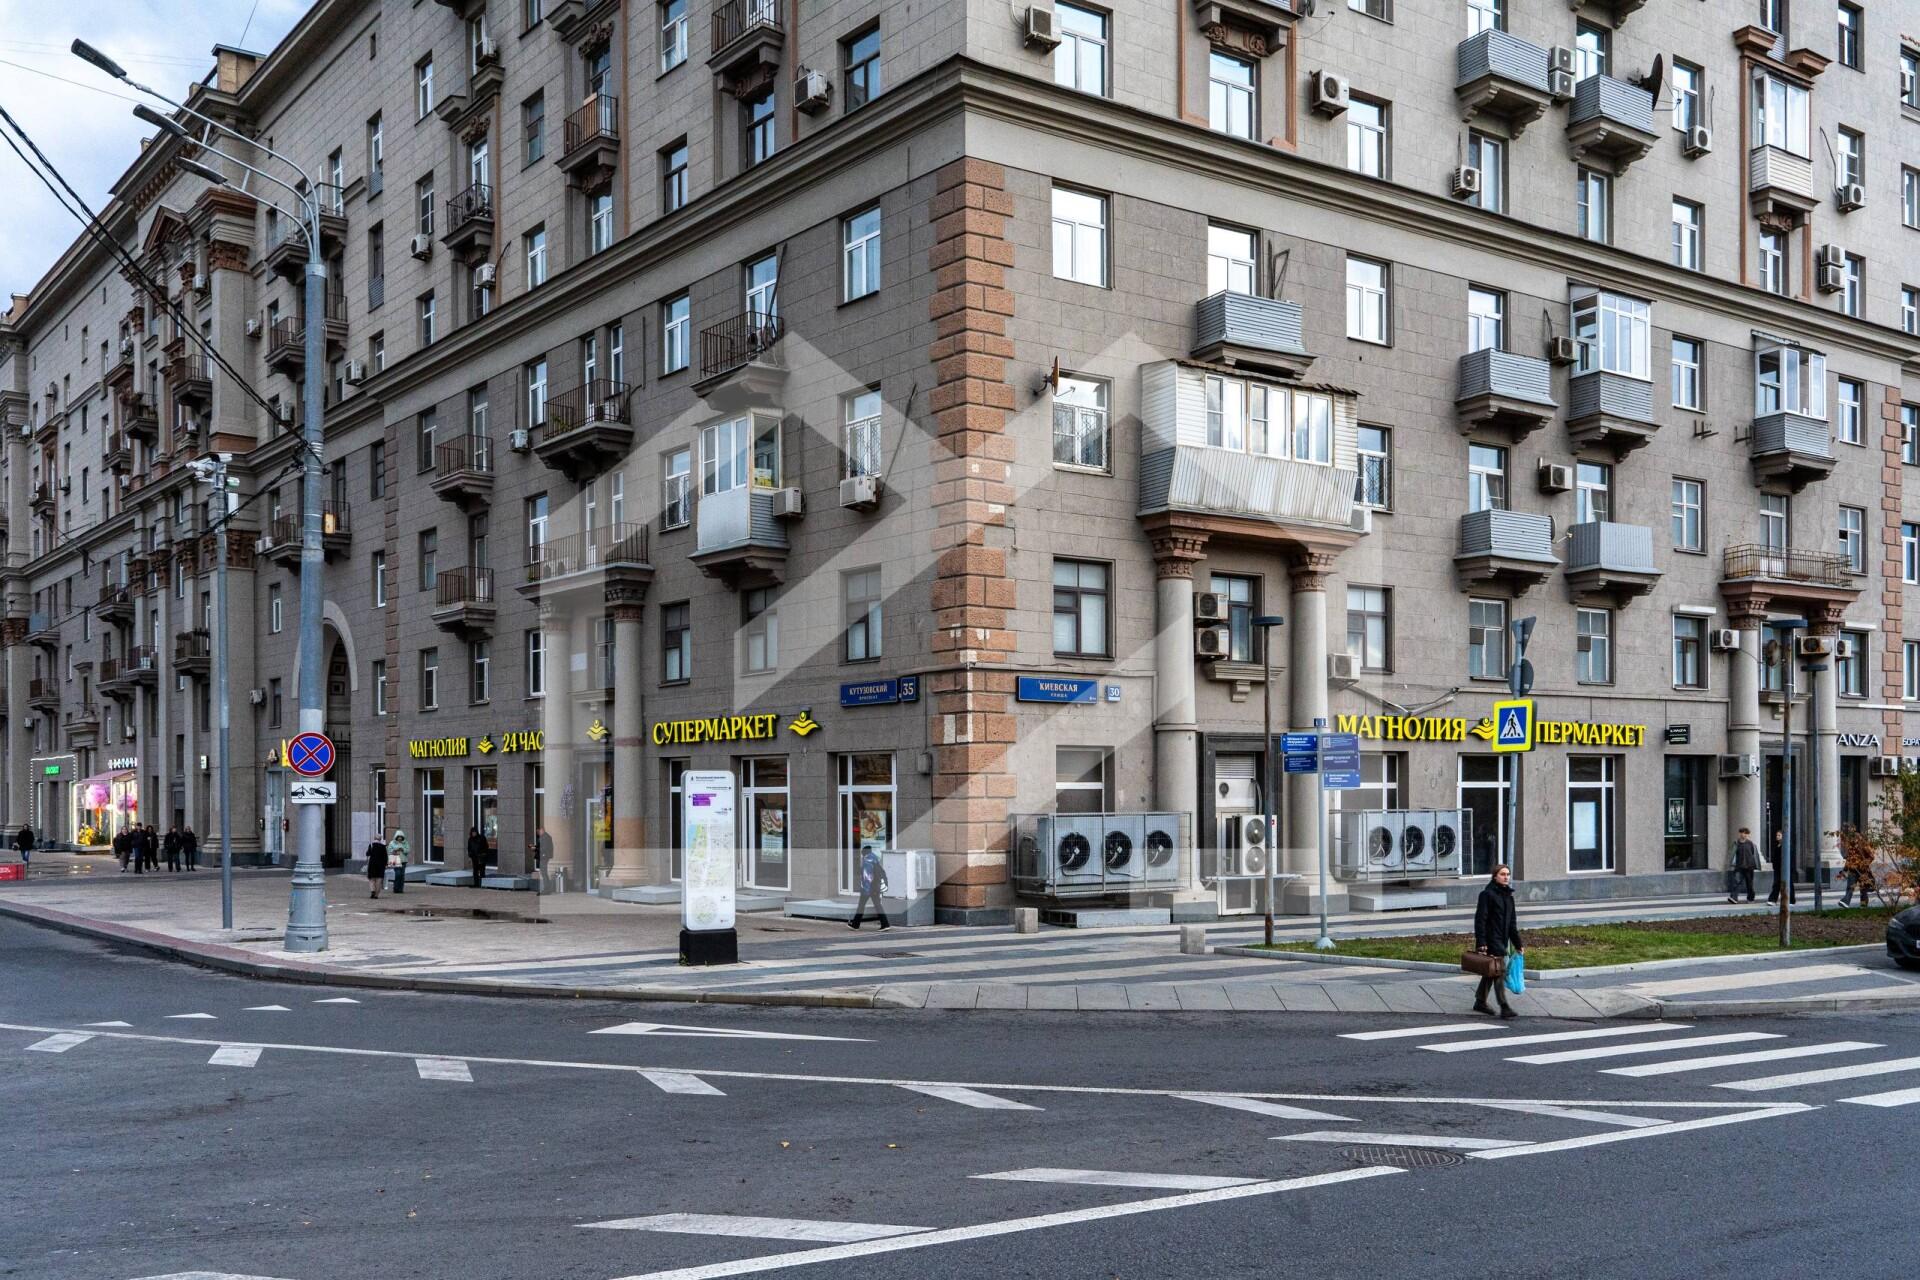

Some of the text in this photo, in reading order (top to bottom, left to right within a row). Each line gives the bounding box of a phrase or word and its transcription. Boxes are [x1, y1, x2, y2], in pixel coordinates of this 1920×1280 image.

[902, 683, 914, 696] 35
[1039, 682, 1078, 692] КИЕВСКАЯ
[1109, 687, 1120, 697] 30
[653, 714, 776, 745] СУПЕРМАРКЕТ
[1337, 714, 1467, 741] МАГНОЛИЯ
[409, 737, 467, 758] МАГНОЛИЯ
[502, 733, 517, 753] 24
